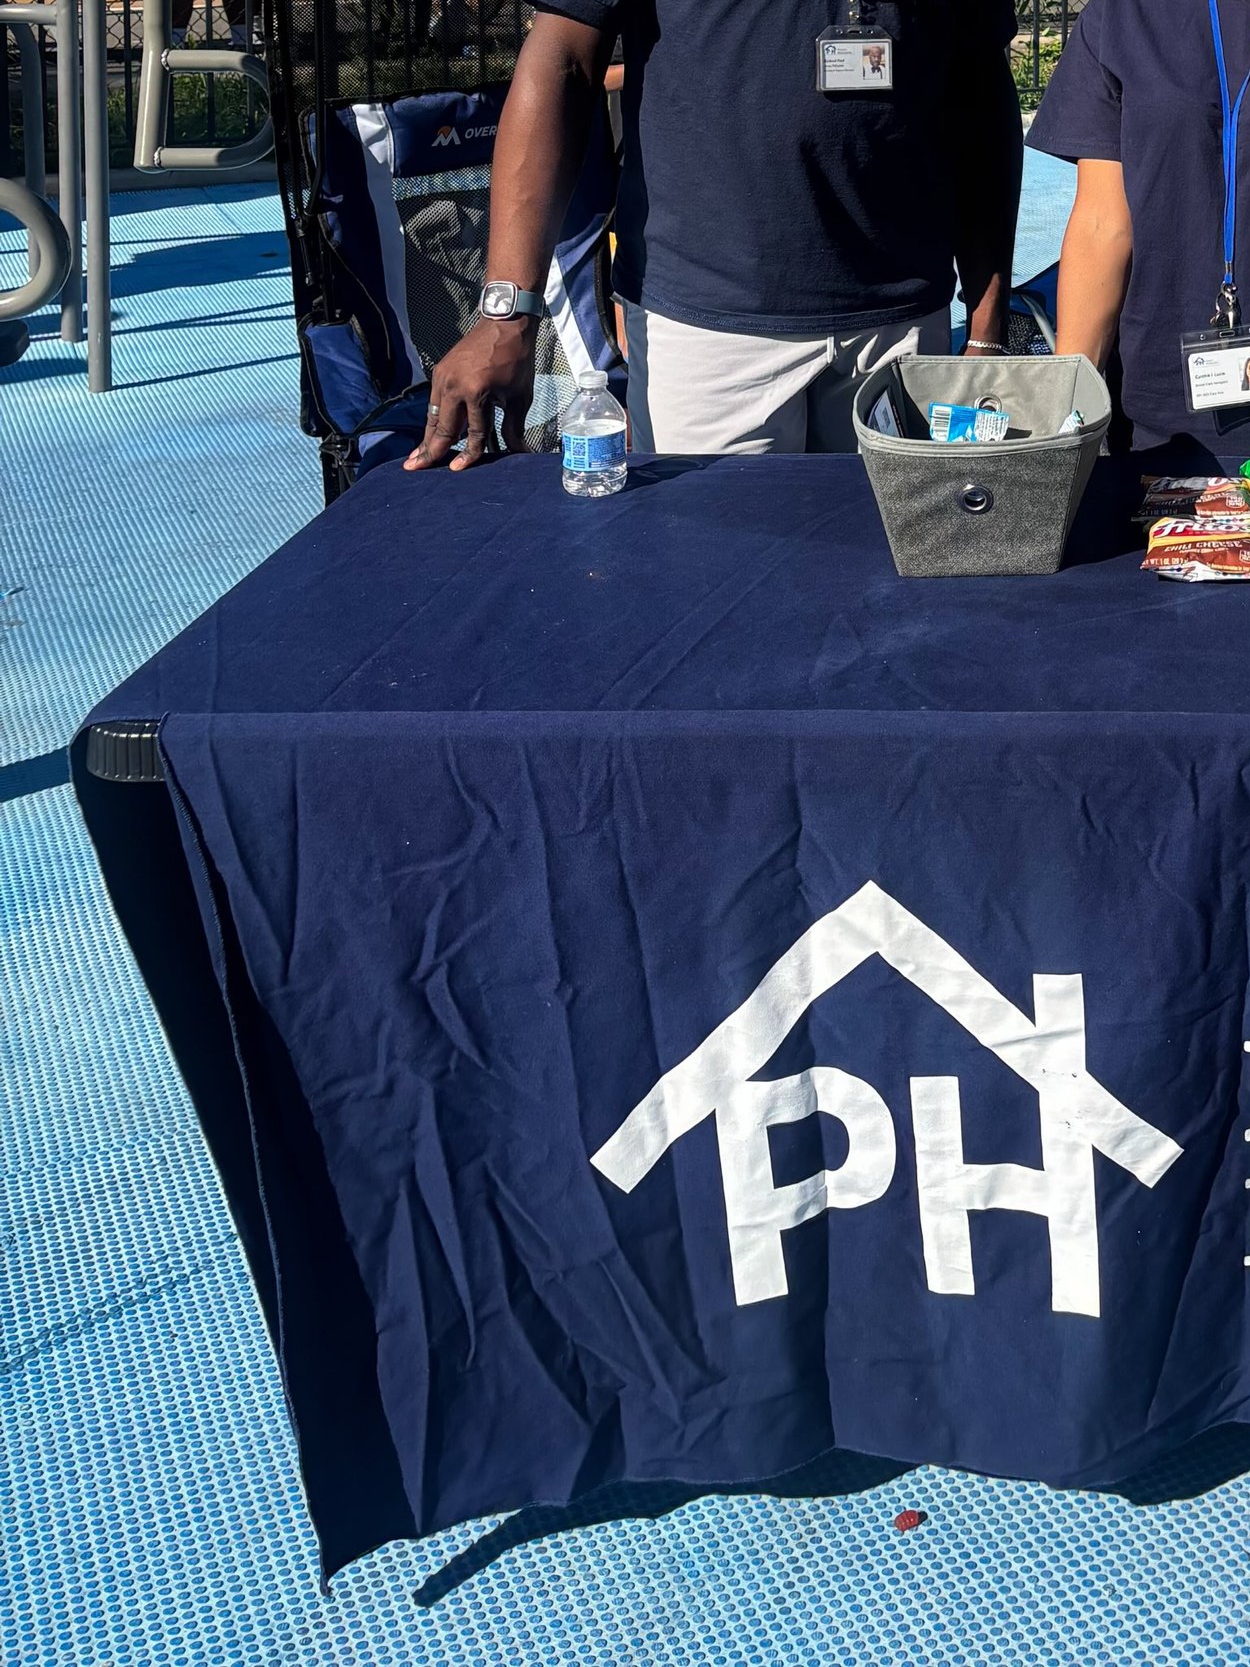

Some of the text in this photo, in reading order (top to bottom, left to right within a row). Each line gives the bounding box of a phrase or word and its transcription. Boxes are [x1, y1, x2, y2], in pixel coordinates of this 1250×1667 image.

[1164, 540, 1243, 552] CHILI CHEESE
[690, 974, 1105, 1319] PH
